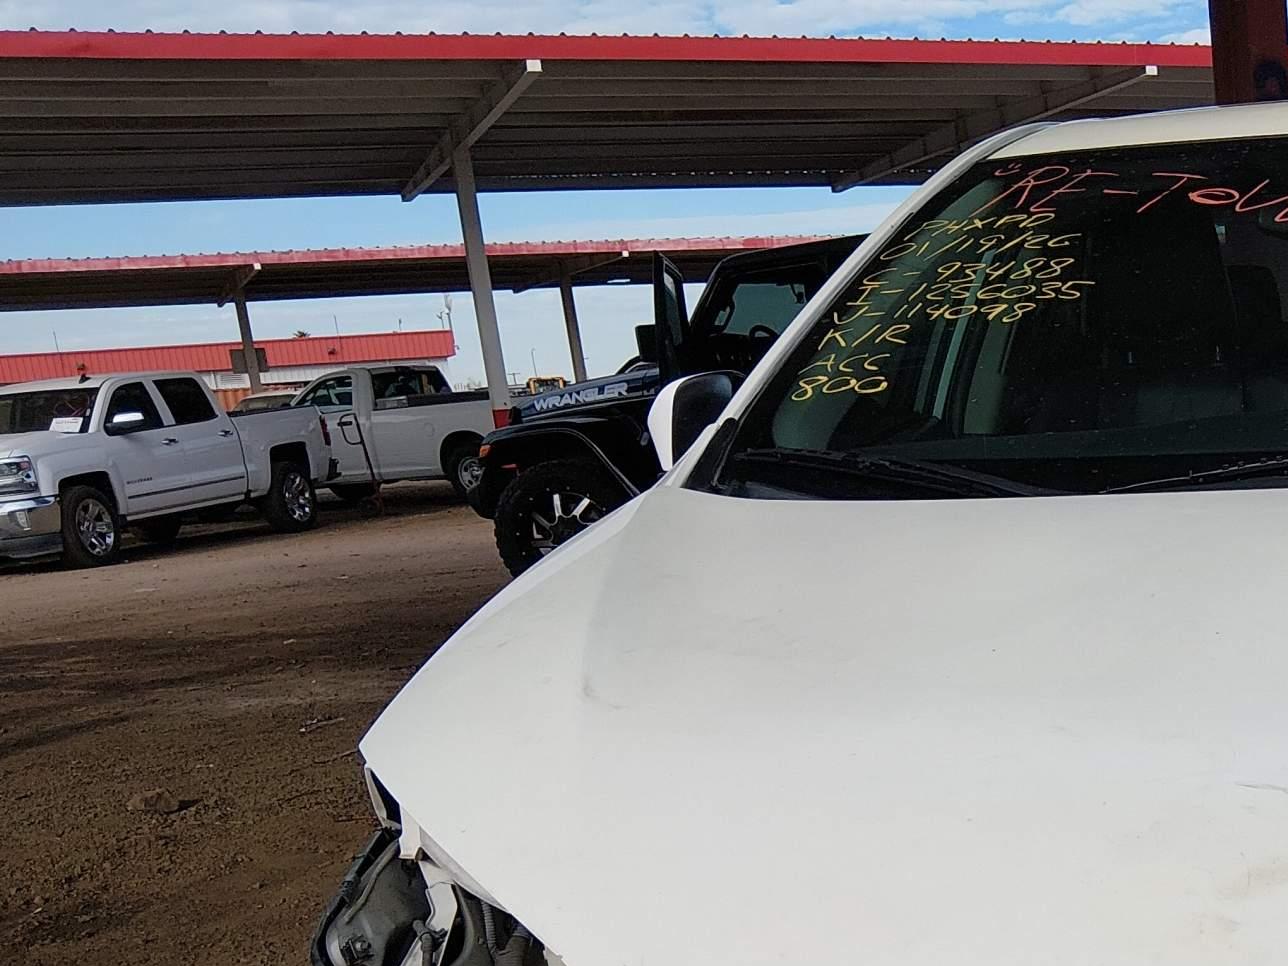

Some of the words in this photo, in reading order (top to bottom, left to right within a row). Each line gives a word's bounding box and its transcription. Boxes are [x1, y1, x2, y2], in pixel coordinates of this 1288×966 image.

[904, 213, 1055, 240] PHXPD
[880, 231, 1082, 261] 01/19/26
[818, 324, 911, 350] K/R
[534, 382, 628, 411] WRANGLER
